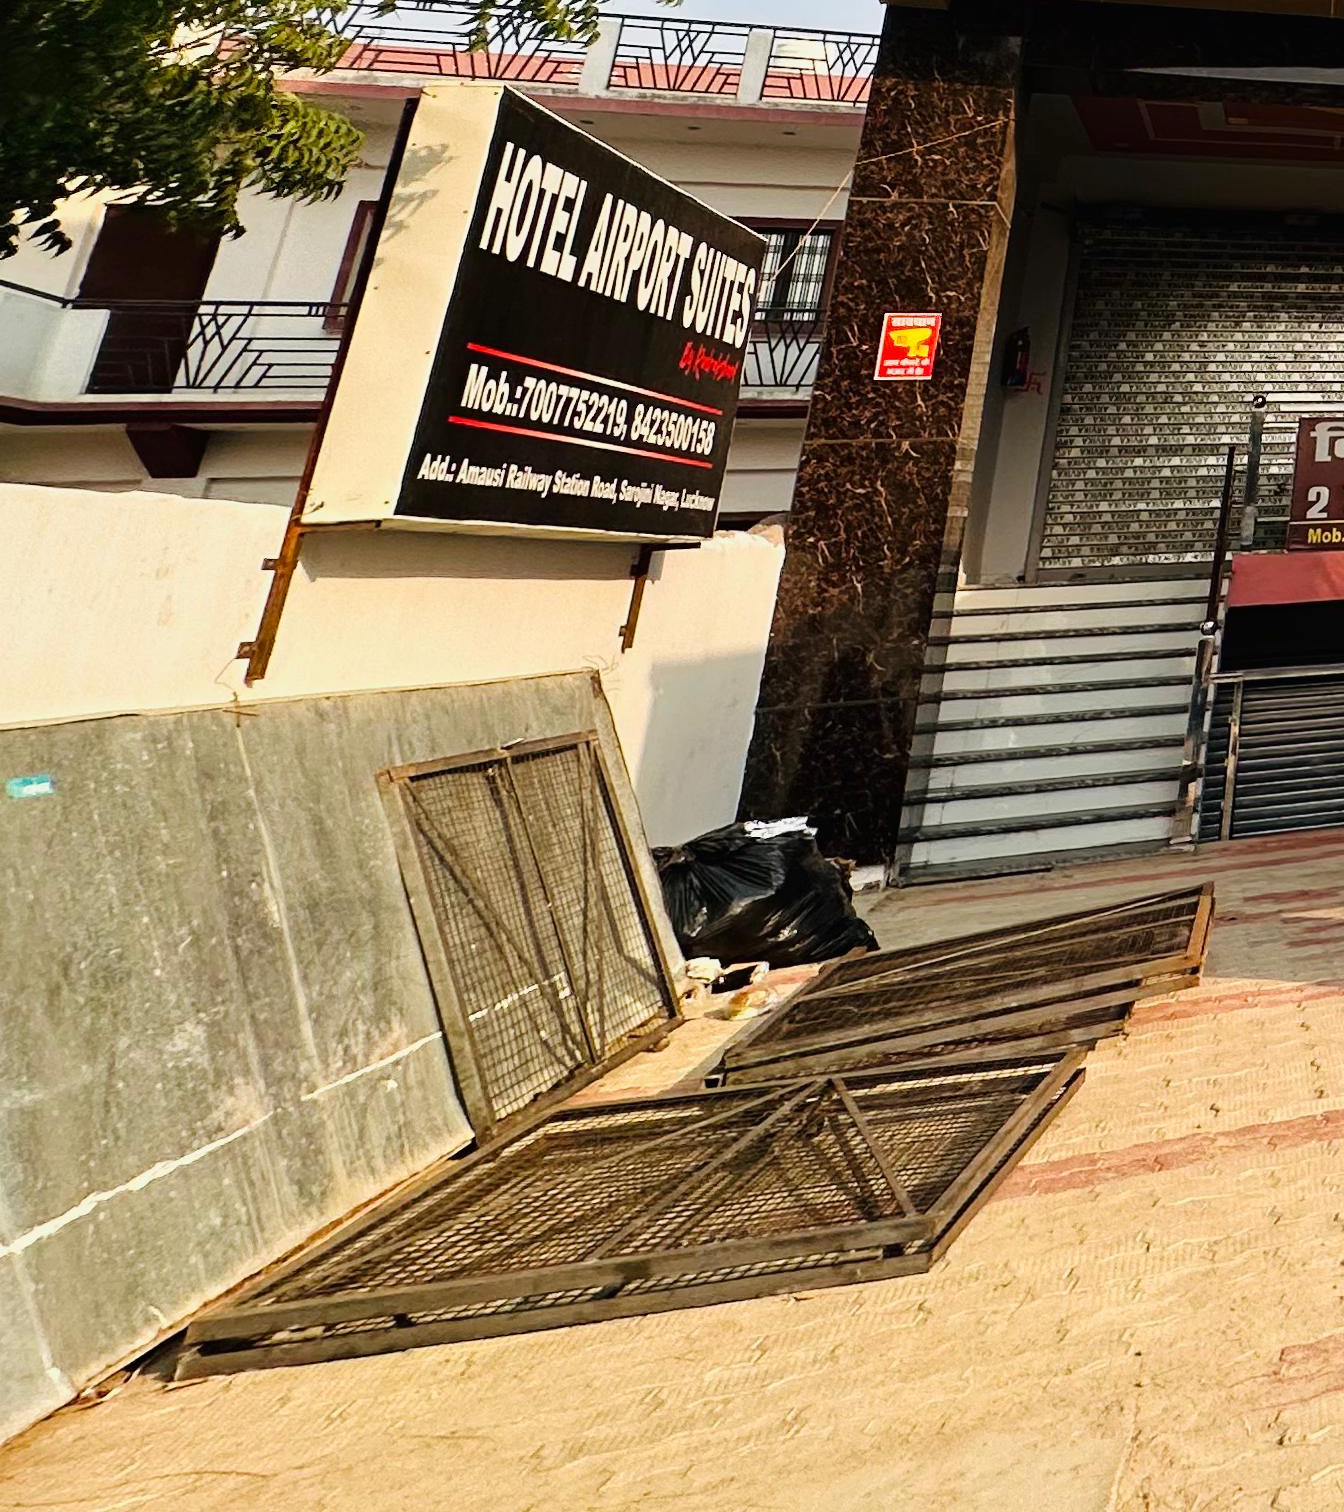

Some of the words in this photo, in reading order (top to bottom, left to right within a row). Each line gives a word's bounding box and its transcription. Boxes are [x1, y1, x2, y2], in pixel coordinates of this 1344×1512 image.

[478, 140, 587, 284] HOTEL
[578, 192, 693, 320] AIRPORT
[682, 240, 756, 349] SUITES
[631, 403, 716, 455] 8423500158
[456, 457, 507, 487] Amausi
[505, 463, 553, 498] Railway
[552, 469, 591, 497] Station
[590, 475, 618, 504] Road,
[1306, 486, 1330, 519] 2
